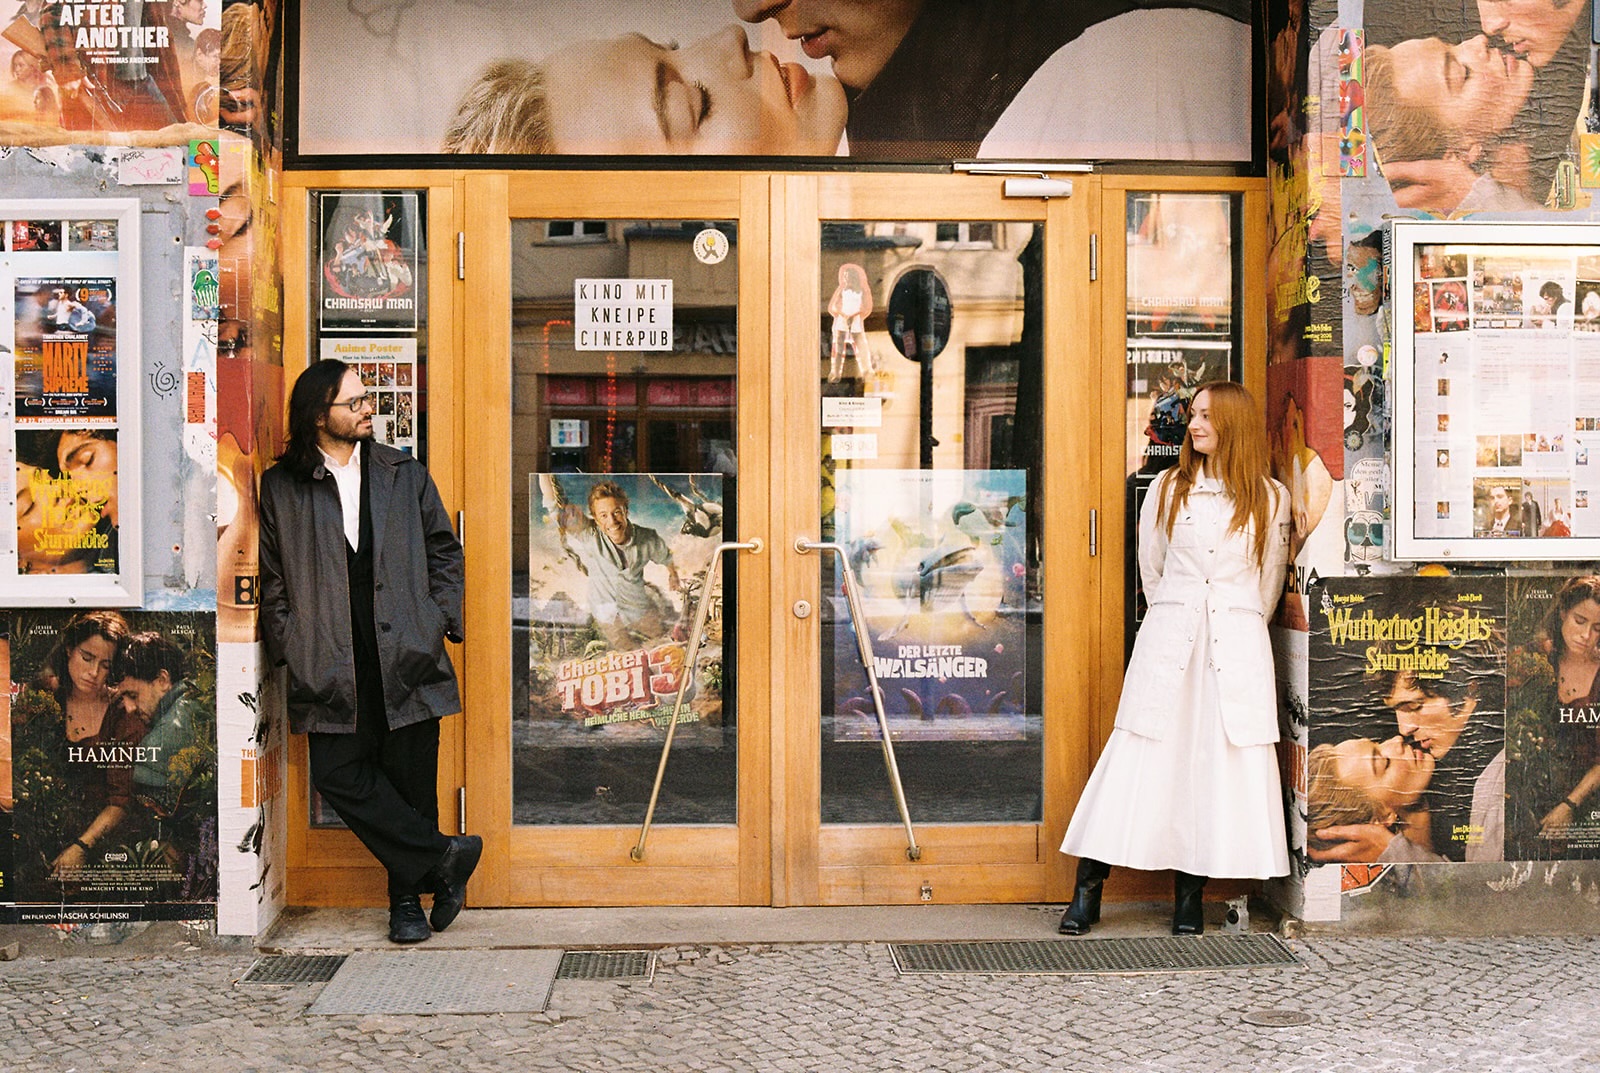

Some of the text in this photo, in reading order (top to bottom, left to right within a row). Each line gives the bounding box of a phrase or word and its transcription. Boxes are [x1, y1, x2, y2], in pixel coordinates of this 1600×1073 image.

[60, 4, 125, 26] AFTER
[75, 26, 170, 49] ANOTHER
[91, 56, 159, 64] PAUL THOMAS ANDERSON
[80, 287, 90, 302] 9
[580, 284, 667, 299] KINO MIT
[324, 297, 413, 310] CHAINSAW MAN
[1141, 297, 1224, 306] CHAINSAW MAN
[591, 307, 656, 323] KNEIPE
[581, 331, 668, 346] CINE&PUB
[334, 344, 403, 353] Anime Poster
[42, 342, 89, 378] MARTY
[42, 375, 89, 393] SUPREME
[33, 527, 109, 552] Sturmhöhe
[898, 645, 962, 658] DER LETZTE
[557, 650, 646, 682] Checker
[874, 656, 988, 678] WALSÄNGER
[1365, 646, 1450, 675] Sturmhöhe
[557, 643, 694, 710] TOBI 3
[584, 710, 629, 725] HEIMLICHE
[68, 747, 162, 763] HAMNET
[90, 912, 130, 920] SCHILINSKI
